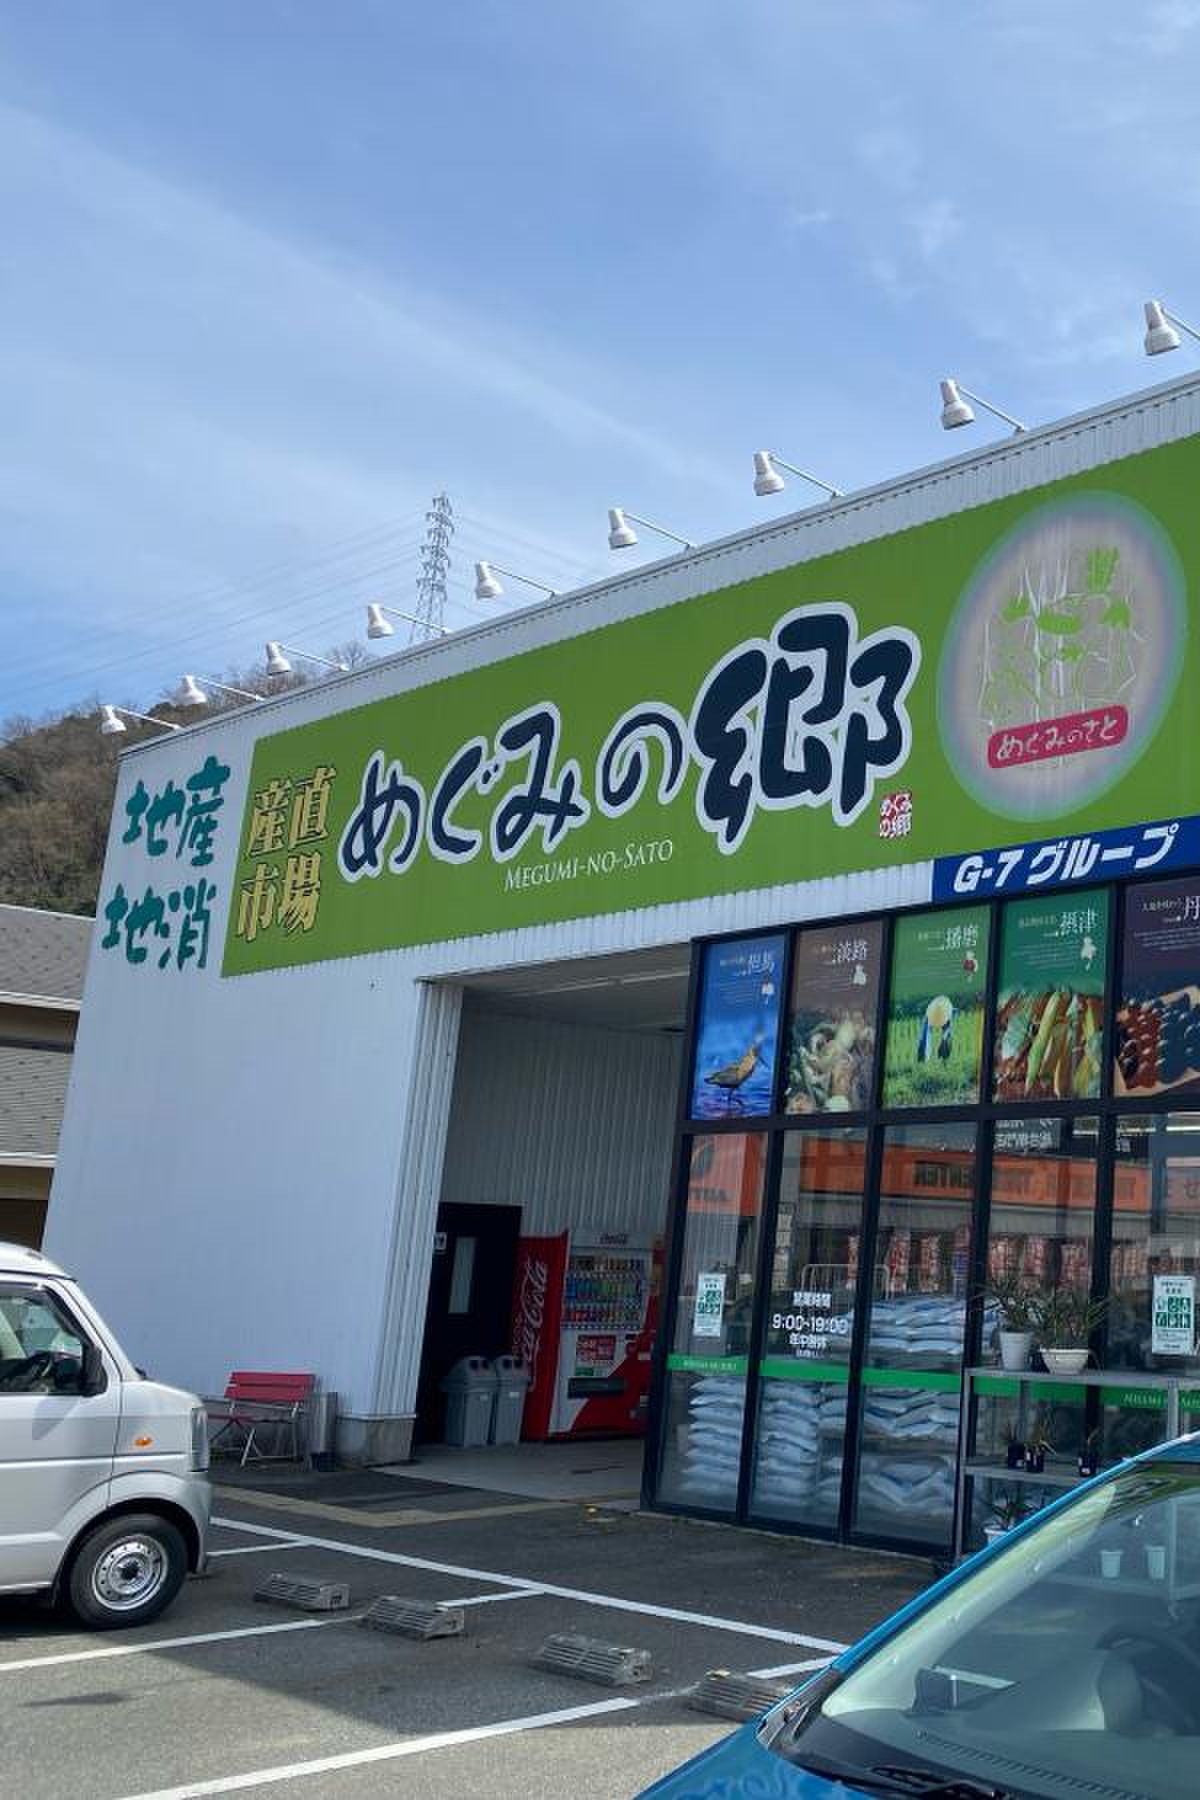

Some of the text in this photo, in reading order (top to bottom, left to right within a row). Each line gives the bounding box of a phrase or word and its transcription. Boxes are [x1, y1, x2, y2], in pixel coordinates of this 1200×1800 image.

[337, 602, 921, 882] めぐみの郷
[997, 715, 1118, 761] めぐみのさと
[122, 755, 231, 866] 地産
[248, 767, 336, 860] 産直
[236, 852, 323, 941] 市場
[504, 839, 673, 892] MEGUMI-NO-SATO
[954, 823, 1180, 893] G-7 グループ
[101, 878, 217, 971] 地消
